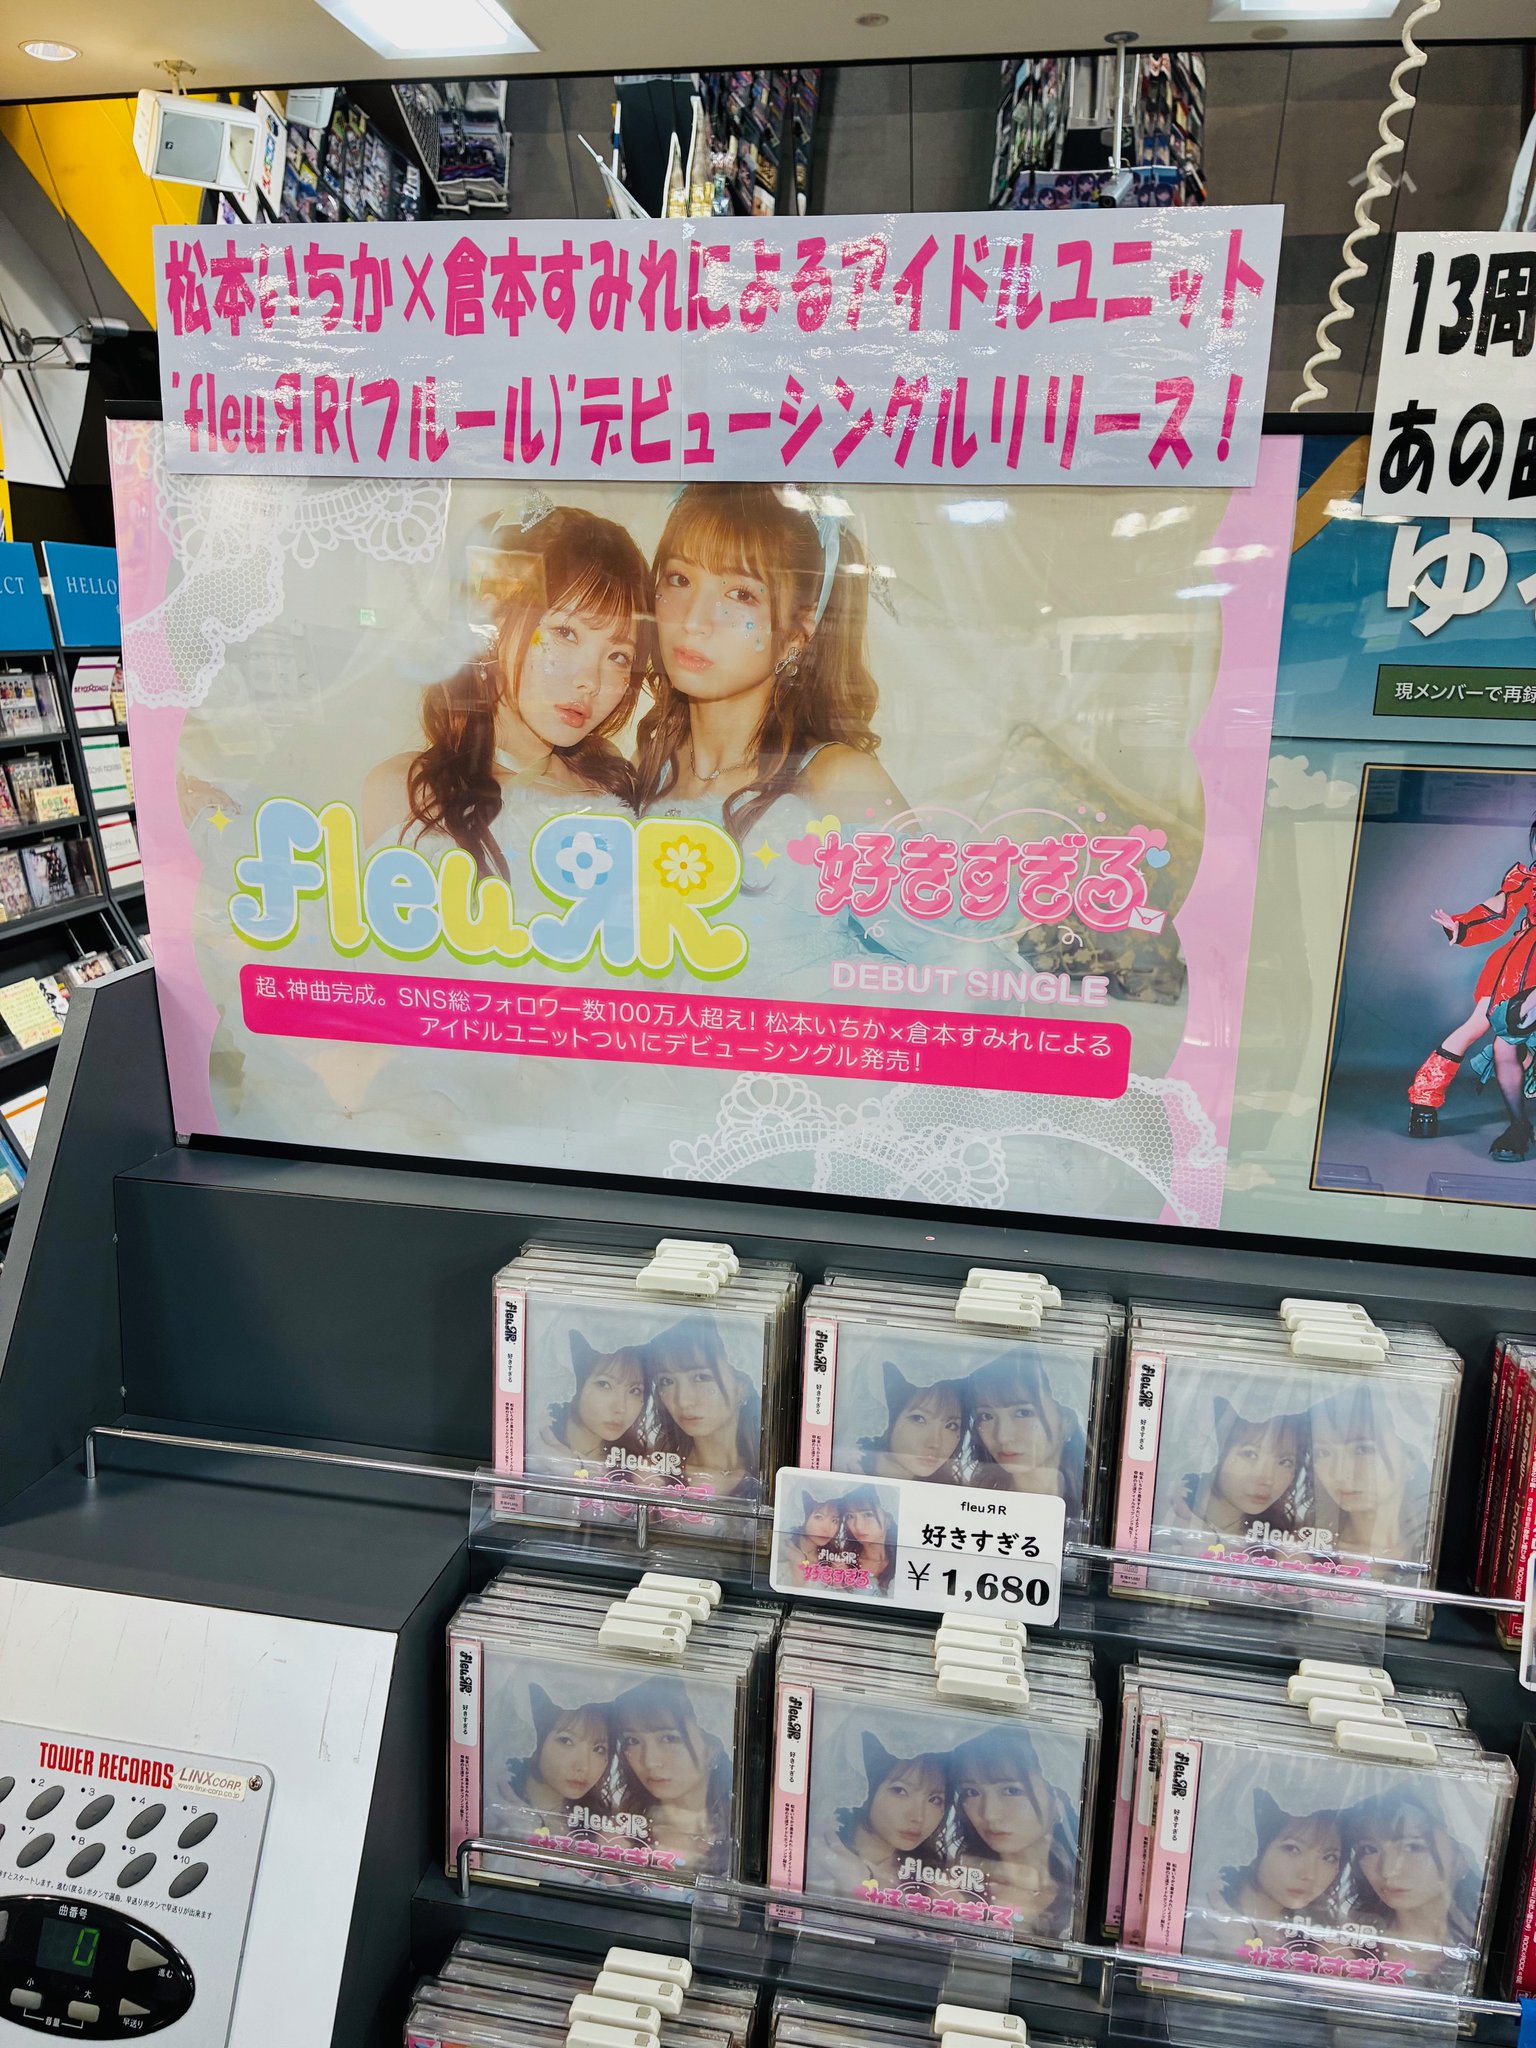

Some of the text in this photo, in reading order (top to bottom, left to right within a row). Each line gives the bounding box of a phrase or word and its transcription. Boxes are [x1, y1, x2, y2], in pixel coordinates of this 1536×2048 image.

[165, 229, 1264, 337] 松本いちか×倉本すみれによるアイドルユニット
[66, 576, 117, 595] HELLO
[815, 829, 1150, 933] 好きすぎる
[831, 961, 1110, 1008] DEBUT SINGLE
[921, 1524, 1041, 1557] 好きすぎる
[907, 1562, 1050, 1607] ¥ 1,680
[40, 1742, 174, 1789] TOWER RECORDS
[37, 1779, 45, 1787] 2
[88, 1788, 96, 1796] 3
[139, 1797, 146, 1805] 4
[190, 1805, 198, 1814] 5
[28, 1827, 35, 1835] 7
[78, 1836, 85, 1845] 8
[129, 1846, 136, 1854] 9
[179, 1855, 191, 1865] 10
[58, 1904, 88, 1920] 曲番号
[71, 1927, 101, 1967] 0
[26, 1978, 35, 1987] 小
[83, 1990, 92, 1999] 大
